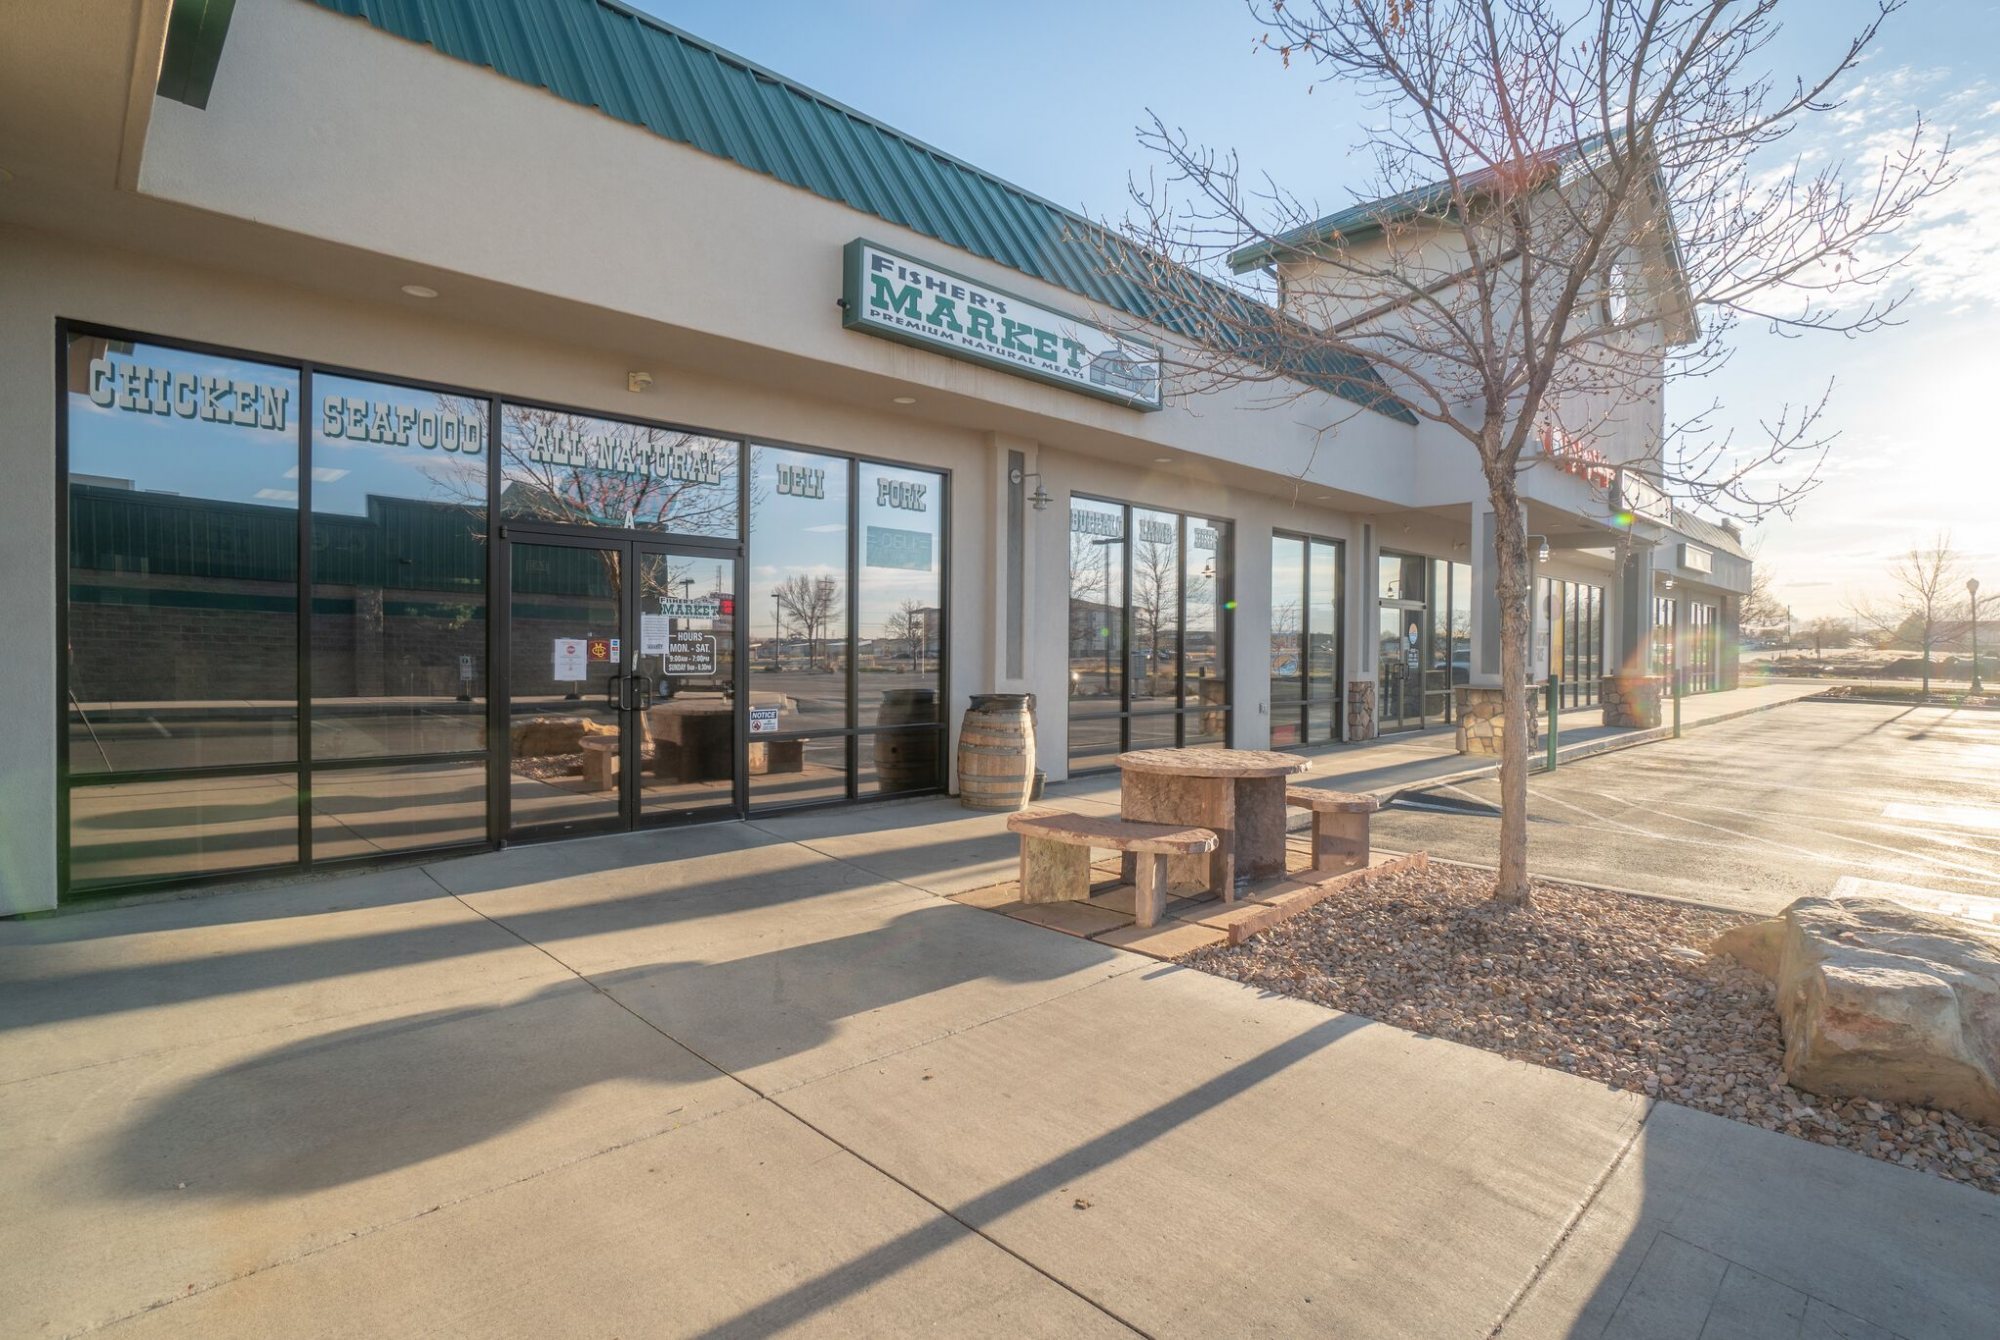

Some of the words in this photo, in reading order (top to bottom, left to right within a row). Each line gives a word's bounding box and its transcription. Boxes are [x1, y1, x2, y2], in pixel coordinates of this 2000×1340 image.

[871, 254, 1007, 315] FISHER'S
[870, 273, 1086, 369] MARKET
[870, 309, 955, 341] PREMIUM
[962, 337, 1036, 366] NATURAL
[1042, 362, 1085, 379] MEATS
[89, 358, 289, 432] CHICKEN
[323, 395, 482, 454] SEAFOOD
[529, 424, 587, 468] ALL
[596, 435, 721, 485] NATURAL
[776, 463, 825, 500] DELI
[877, 477, 927, 512] PORK
[662, 604, 718, 616] MARKET
[670, 643, 690, 653] MON.
[695, 643, 711, 653] SAT.
[677, 632, 703, 641] HOURS
[751, 711, 777, 720] NOTICE
